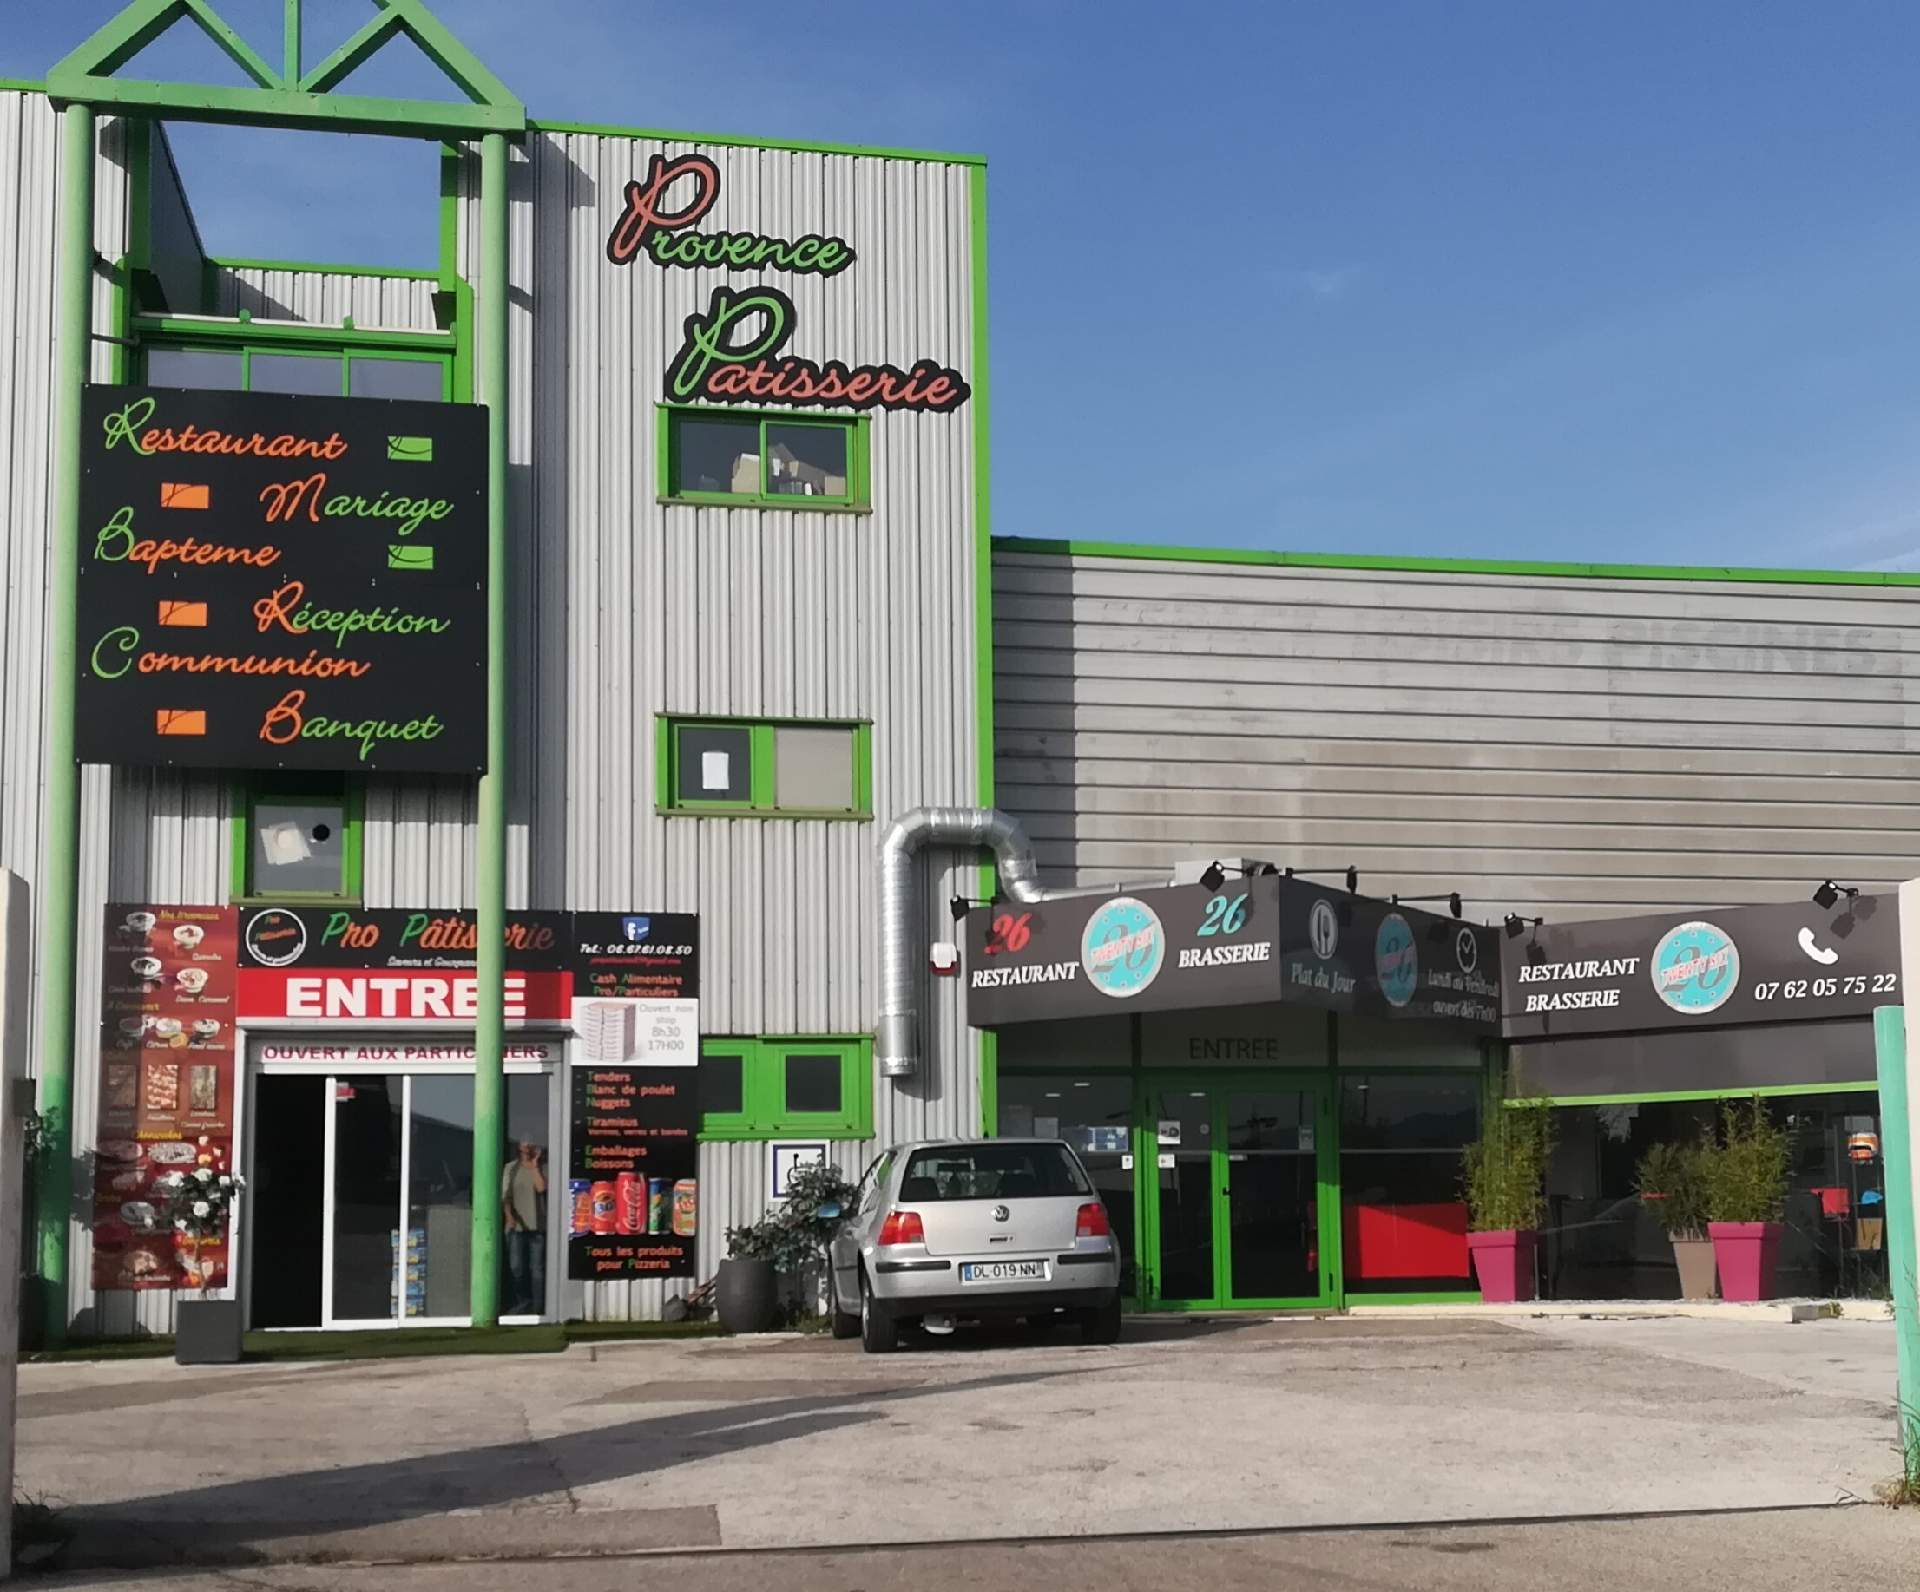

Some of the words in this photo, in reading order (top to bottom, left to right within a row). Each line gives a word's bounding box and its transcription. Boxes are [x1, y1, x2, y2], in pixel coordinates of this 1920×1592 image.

[613, 160, 849, 269] Provence
[674, 296, 958, 406] Patisserie
[103, 397, 348, 459] Restaurant
[259, 473, 455, 535] Mariage
[94, 506, 282, 574] Bapteme
[253, 581, 451, 649] Réception
[91, 626, 372, 679] Communion
[259, 690, 445, 761] Banquet
[321, 911, 380, 949] Pro
[1197, 893, 1248, 937] 26
[1178, 941, 1272, 968] BRASSERIE
[1518, 957, 1641, 983] RESTAURANT
[589, 973, 617, 984] Cash
[622, 973, 683, 985] Alimentaire
[971, 961, 1080, 988] RESTAURANT
[1291, 963, 1312, 988] Plat
[1314, 966, 1330, 991] du
[1331, 970, 1357, 995] Jour
[1754, 981, 1781, 1001] 07
[1783, 979, 1809, 999] 62
[1811, 977, 1838, 998] 05
[1841, 975, 1867, 997] 75
[1870, 973, 1898, 994] 22
[1525, 989, 1621, 1012] BRASSERIE
[264, 1046, 351, 1060] OUVERT
[357, 1046, 400, 1060] AUX
[1189, 1037, 1280, 1060] ENTREE
[621, 1084, 636, 1095] de
[993, 1263, 1017, 1277] 019
[1020, 1263, 1036, 1275] NN
